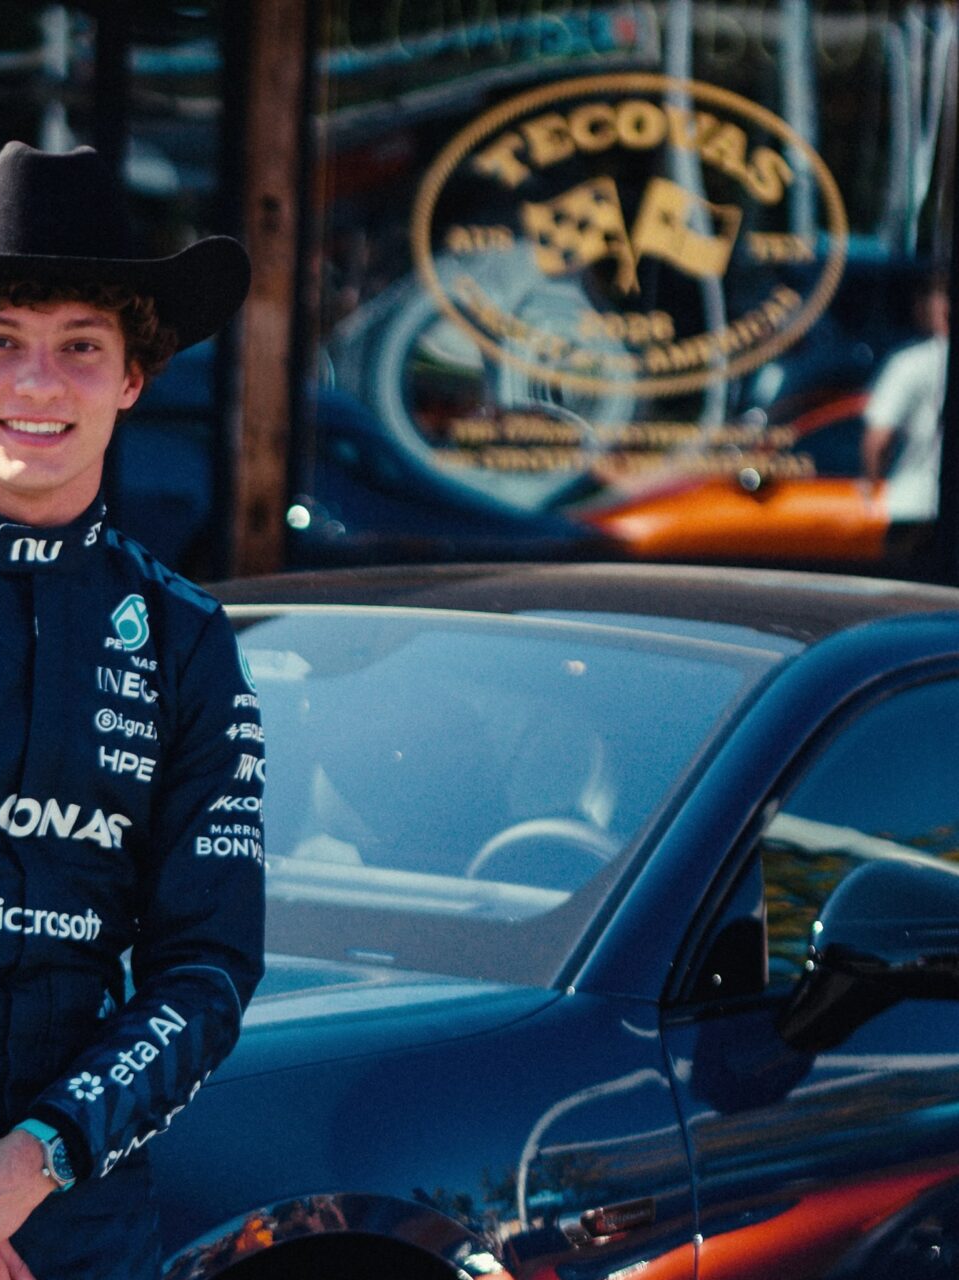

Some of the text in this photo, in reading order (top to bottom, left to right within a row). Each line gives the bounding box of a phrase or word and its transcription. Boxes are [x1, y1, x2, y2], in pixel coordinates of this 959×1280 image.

[474, 98, 793, 205] TECOVAS
[10, 537, 63, 562] nu
[95, 708, 158, 741] Signi
[99, 745, 157, 782] HPE
[211, 824, 261, 839] MARRIO
[109, 1039, 160, 1087] eta
[147, 1004, 188, 1047] AI
